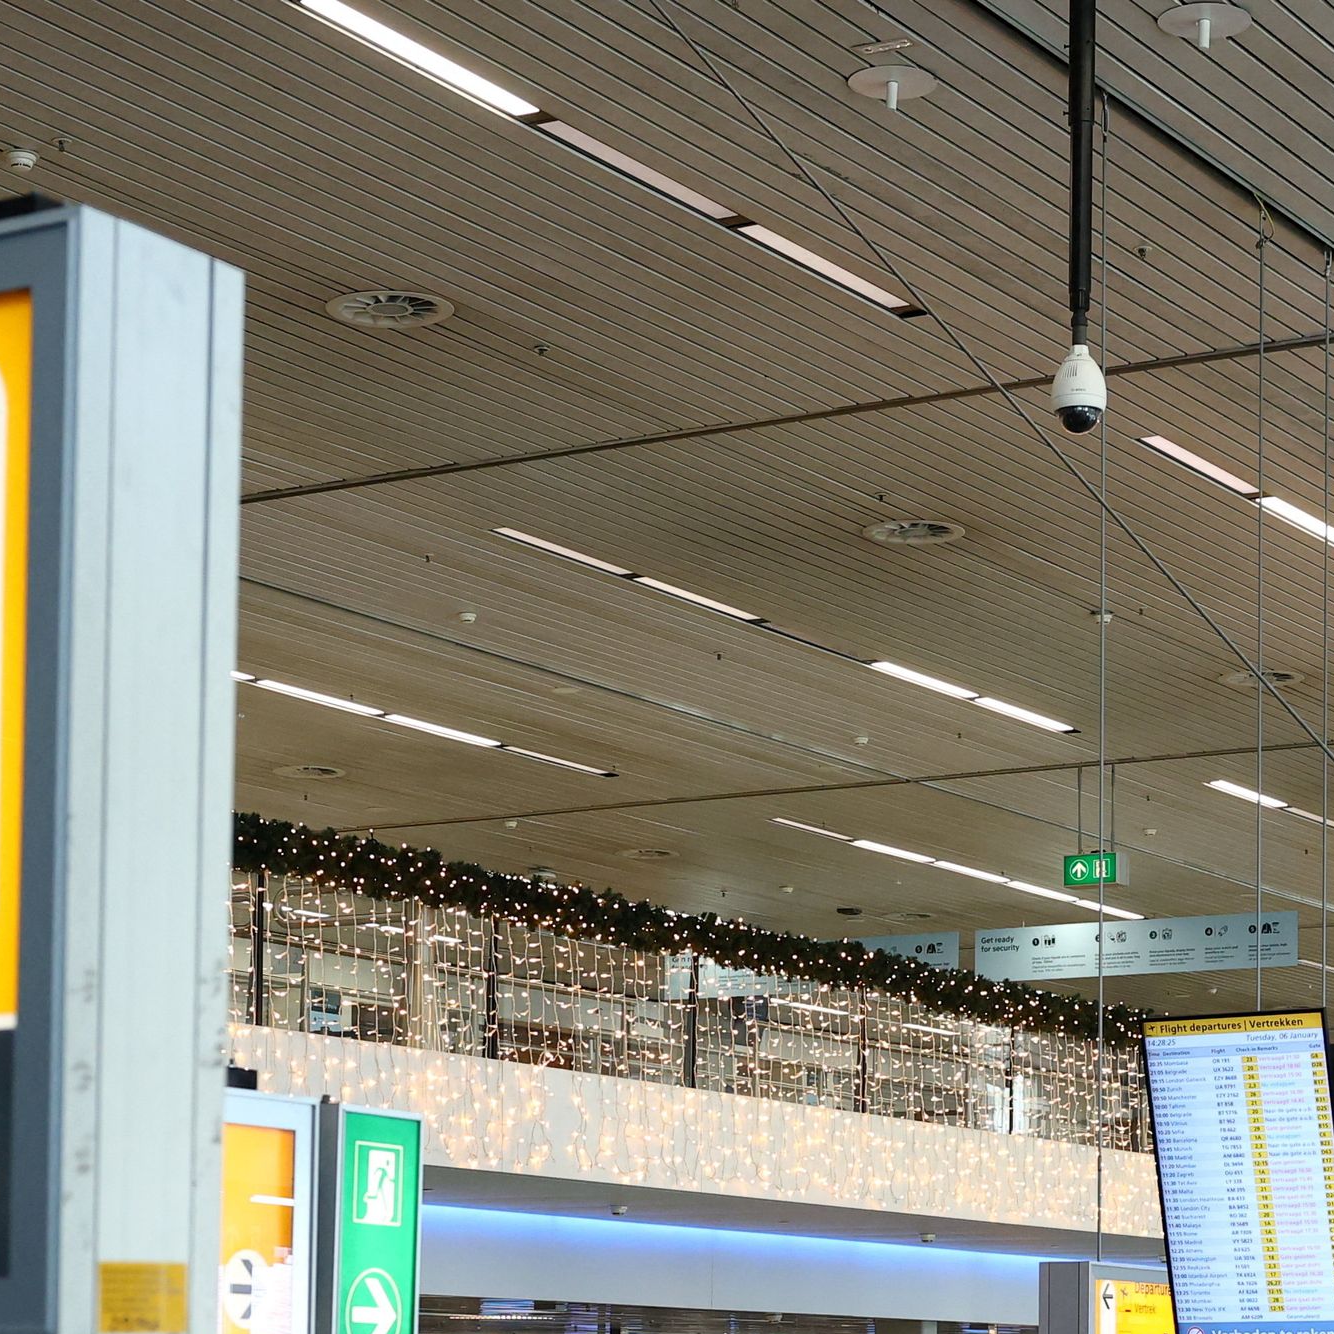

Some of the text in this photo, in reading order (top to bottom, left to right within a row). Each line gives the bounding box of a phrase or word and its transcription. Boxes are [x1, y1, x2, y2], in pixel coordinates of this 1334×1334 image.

[995, 936, 1014, 944] ready
[1160, 1019, 1303, 1035] Flight departures Vertrekken
[1289, 1031, 1318, 1039] January
[1135, 1305, 1156, 1314] Vertrek
